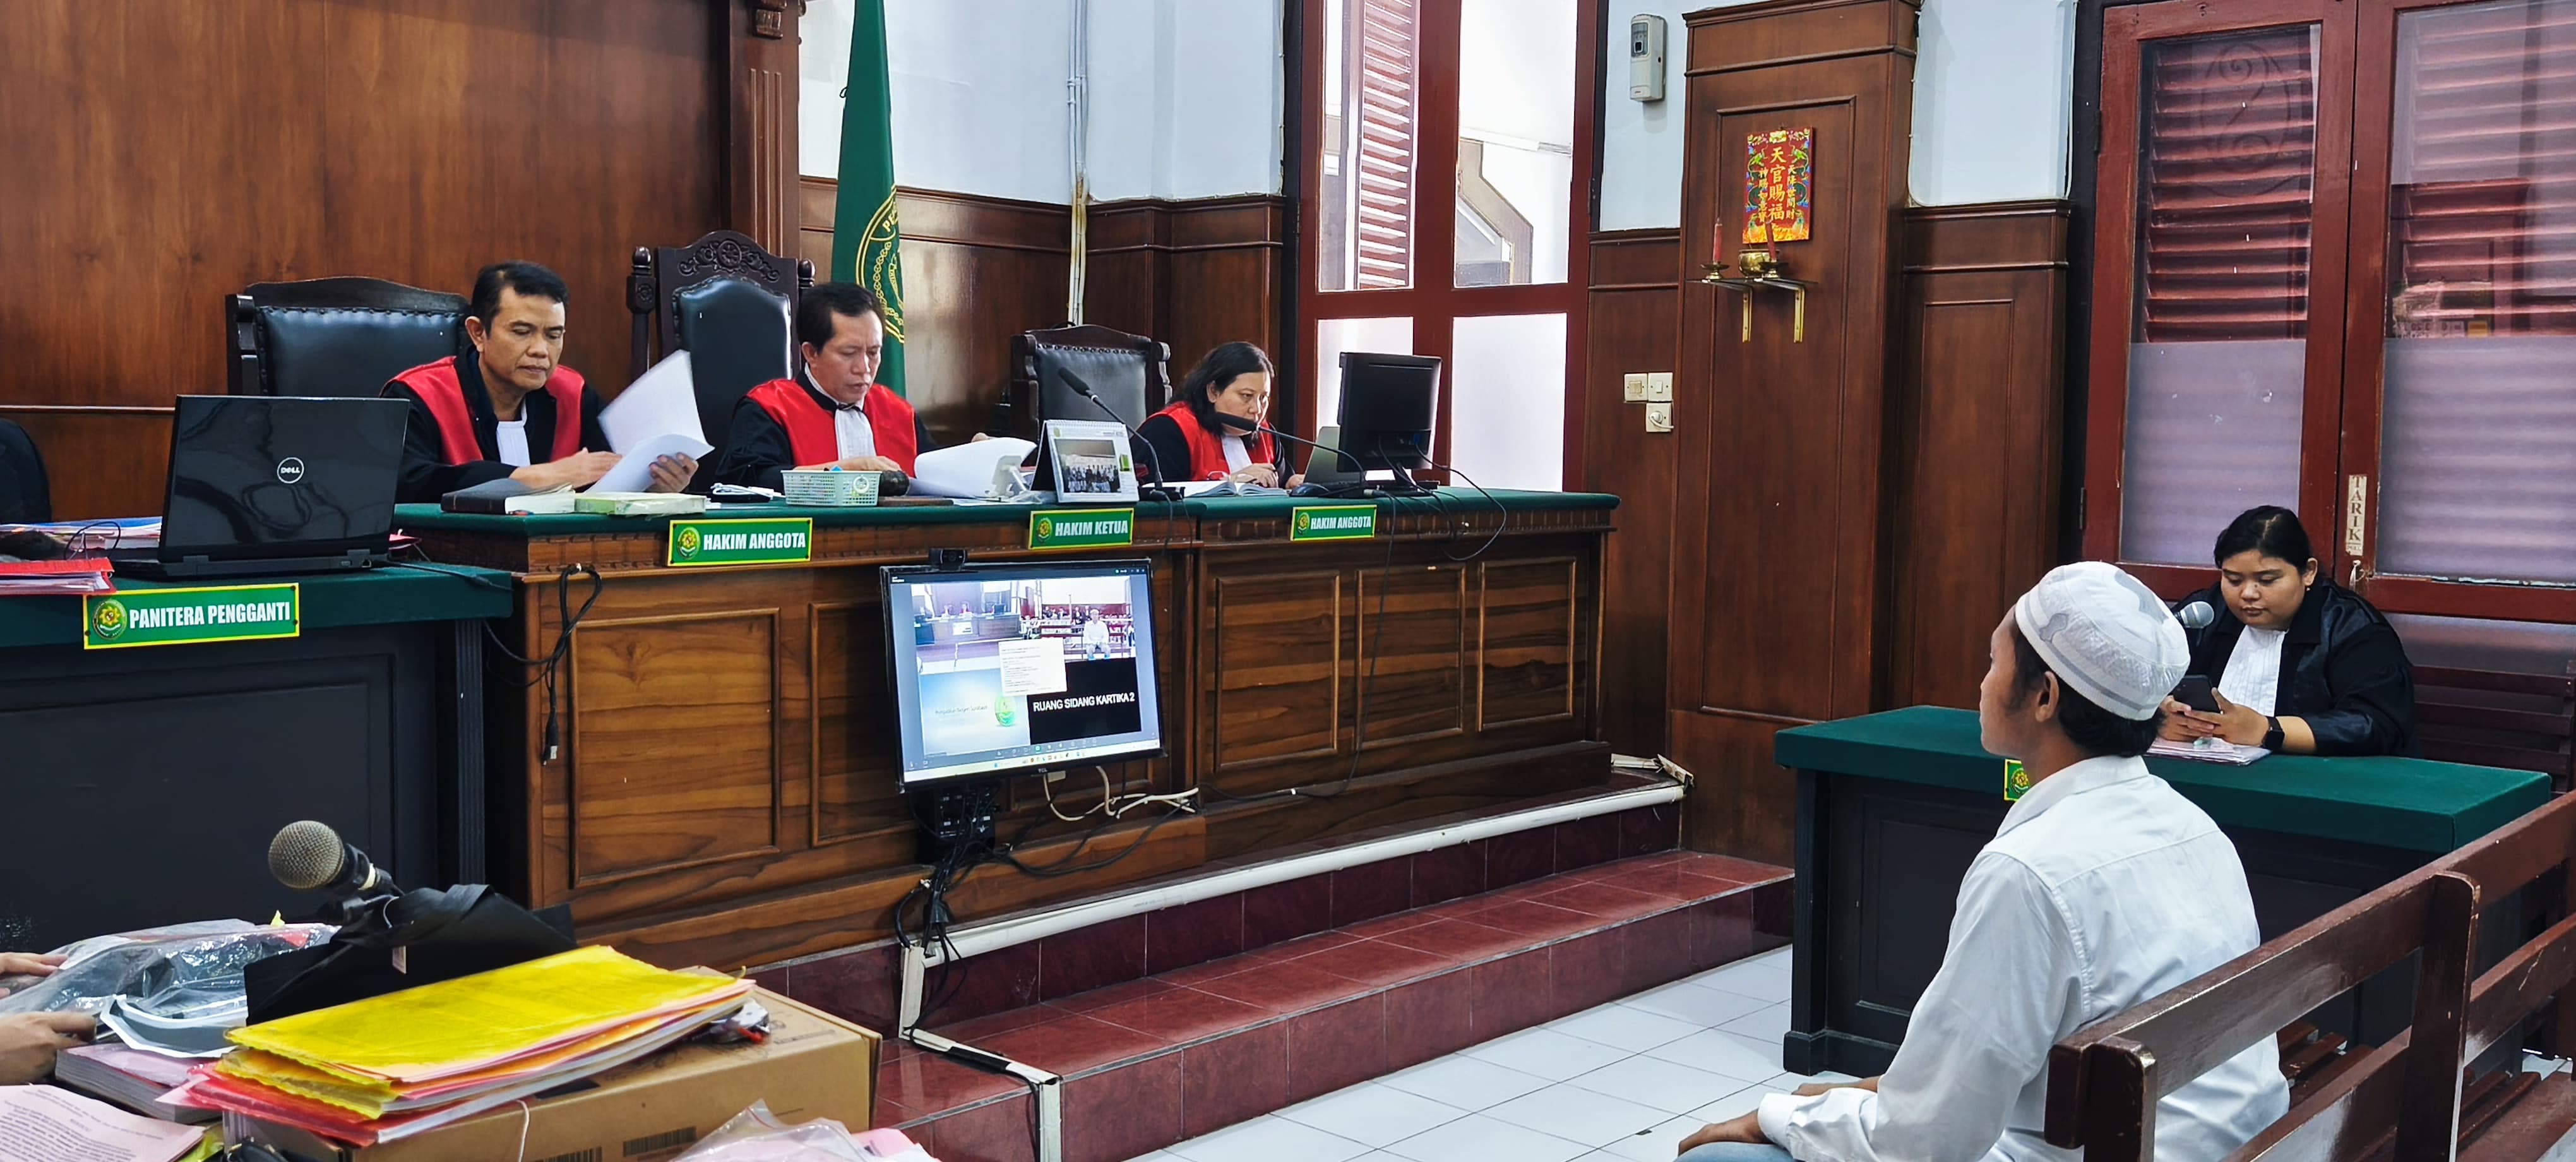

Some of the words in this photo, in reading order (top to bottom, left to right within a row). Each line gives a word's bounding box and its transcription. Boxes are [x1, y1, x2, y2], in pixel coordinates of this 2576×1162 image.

[1768, 146, 1787, 220] 天官賜福
[2349, 476, 2363, 541] TARIK
[1055, 522, 1093, 536] HAKIM
[1094, 520, 1128, 535] KETUA
[1310, 517, 1337, 530] HAKIM
[1337, 516, 1371, 529] ANGGOTA
[703, 534, 747, 550] HAKIM
[749, 532, 806, 549] ANGGOTA
[129, 606, 205, 628] PANITERA
[208, 602, 290, 624] PENGGANTI
[1033, 700, 1063, 712] RUANG
[1064, 697, 1095, 709] SIDANG
[1095, 693, 1130, 705] KARTIKA
[1130, 692, 1135, 702] 2
